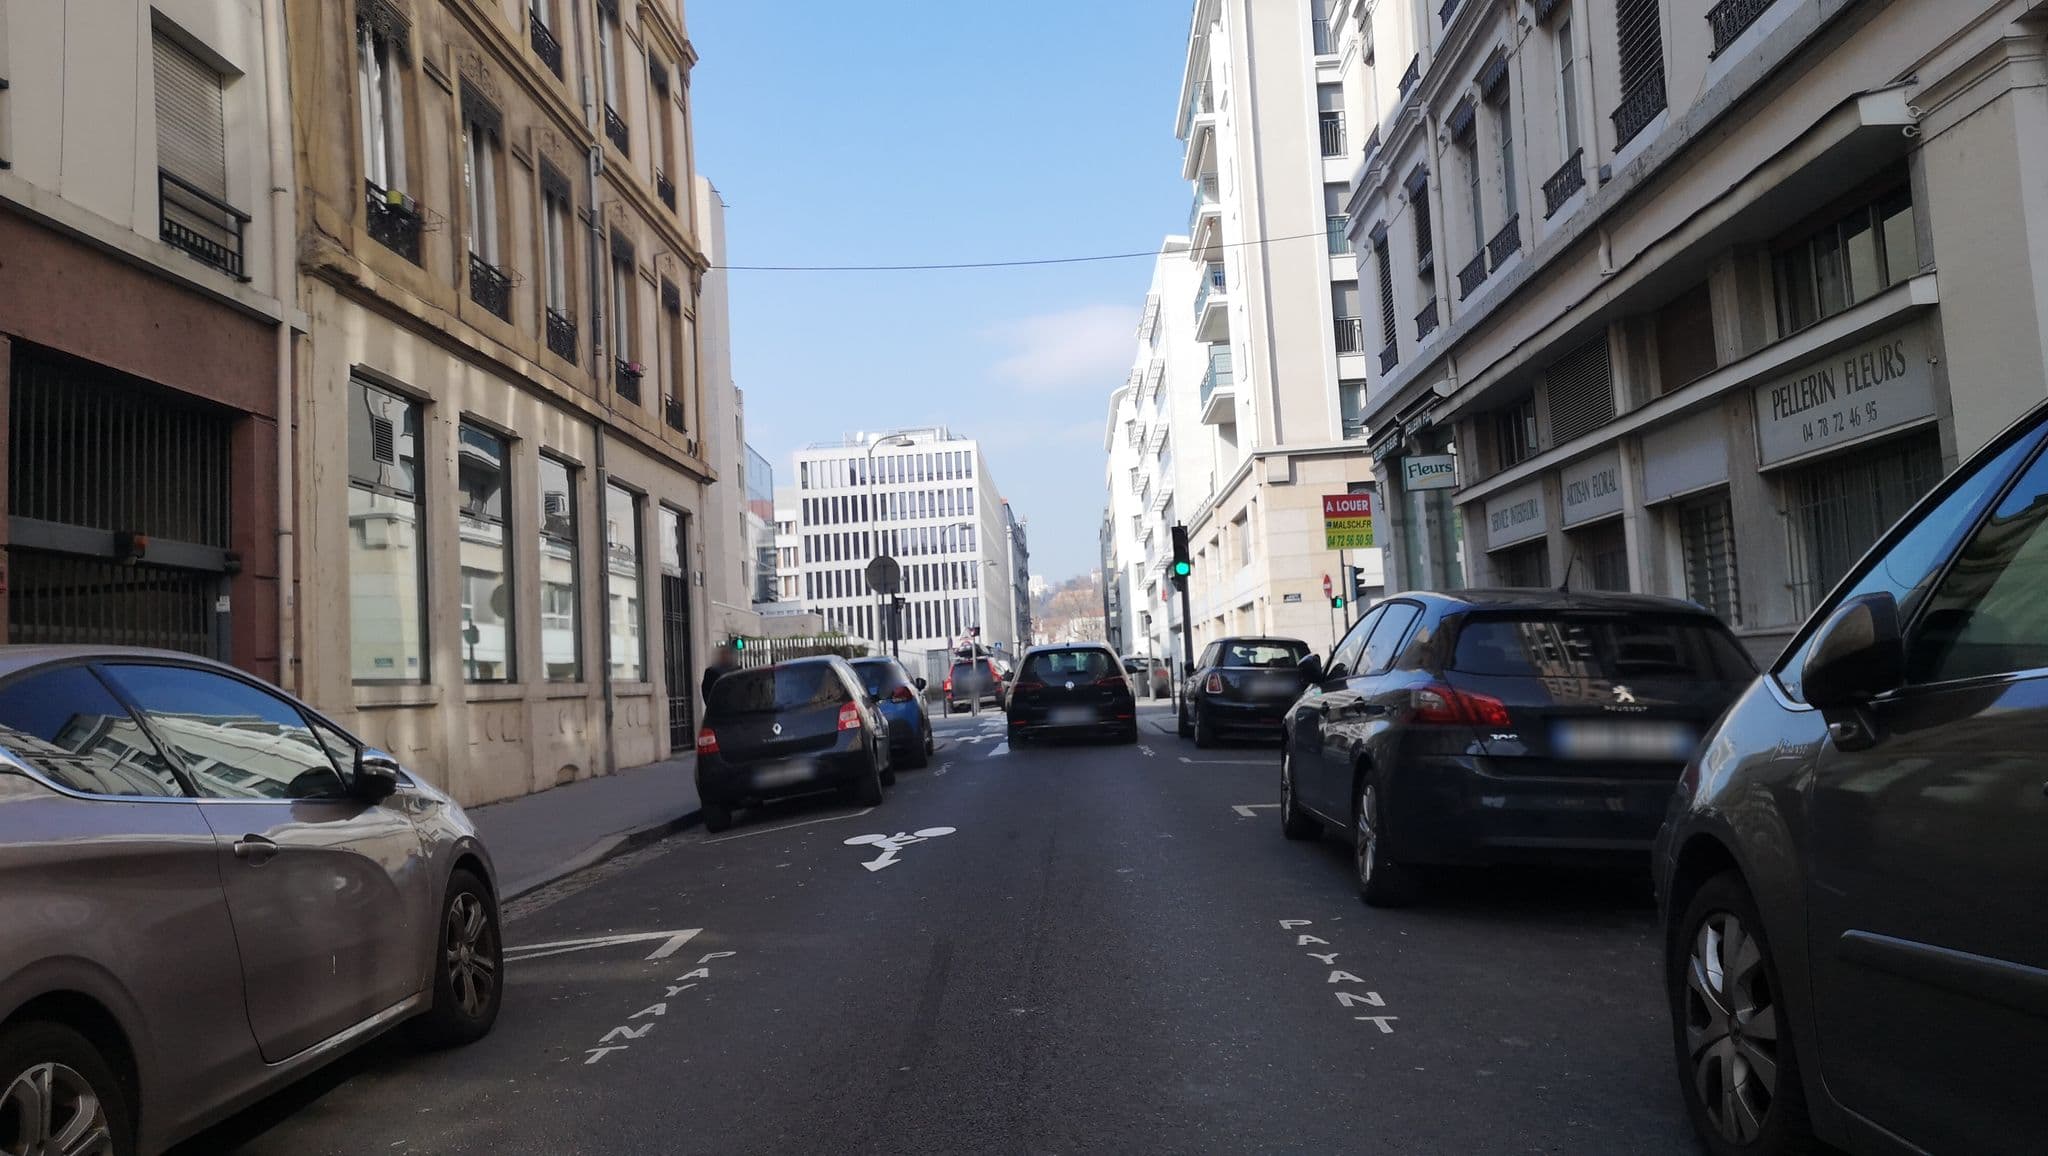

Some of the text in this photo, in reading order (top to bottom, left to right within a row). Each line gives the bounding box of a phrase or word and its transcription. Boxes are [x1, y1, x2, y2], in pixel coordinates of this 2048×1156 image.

[1771, 340, 1906, 421] PELLERIN FLEURS
[1803, 401, 1878, 443] 04 78 72 46 95
[1407, 462, 1453, 478] Fleurs
[1592, 468, 1617, 498] FLORAL
[1326, 500, 1368, 512] A LOUER
[1279, 919, 1401, 1034] PAYANT
[585, 951, 737, 1065] PAYANT
